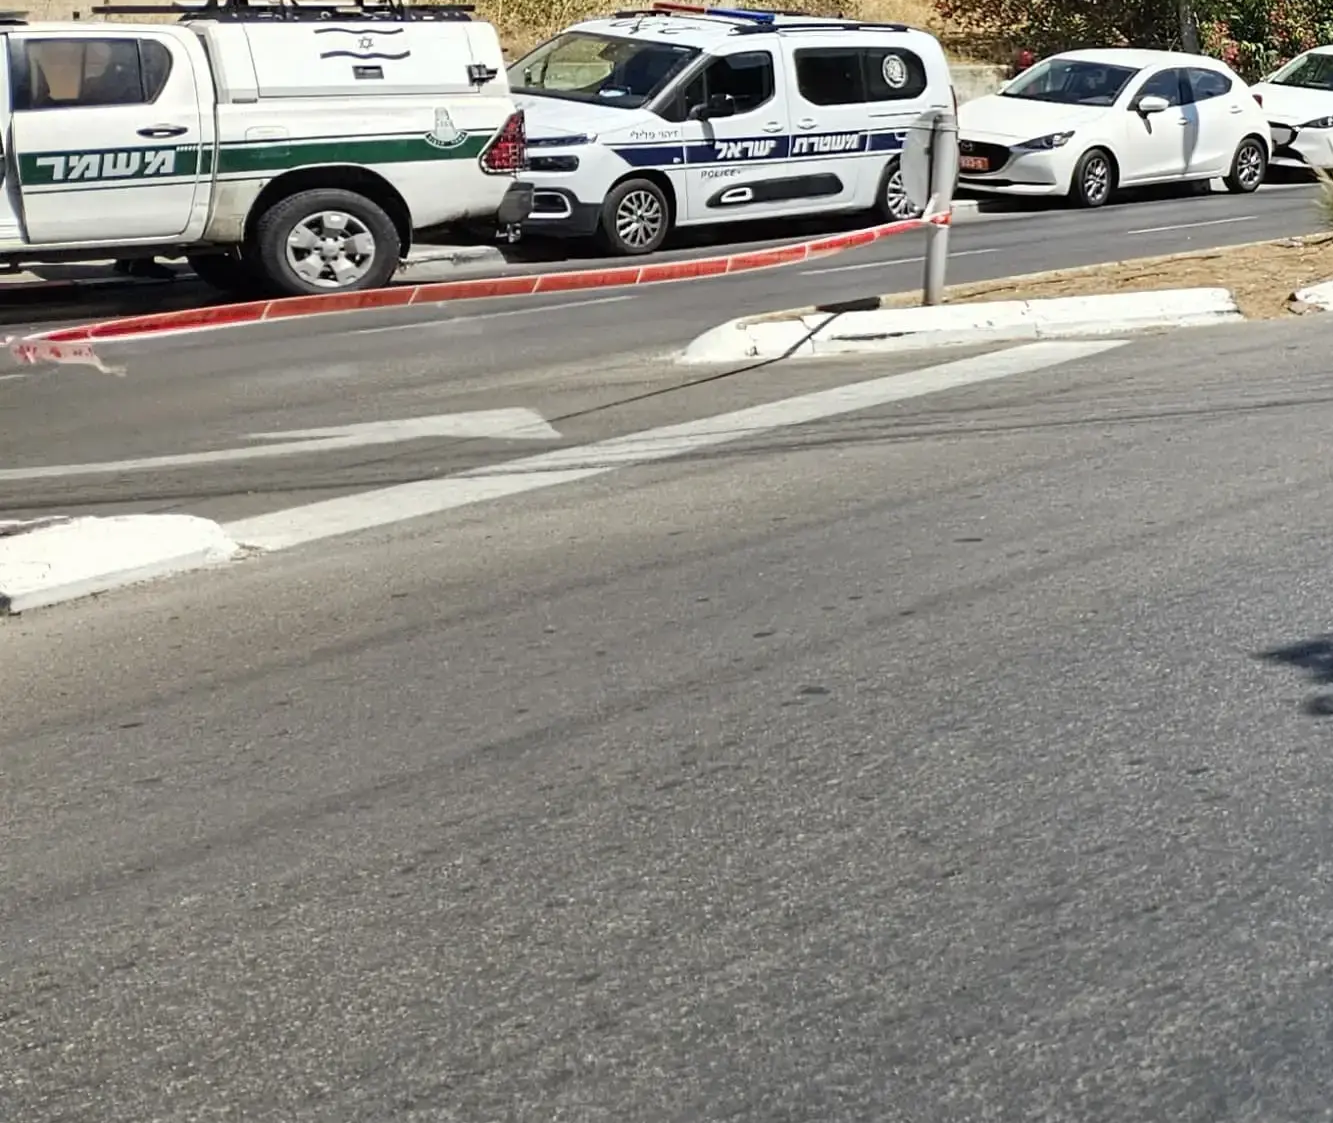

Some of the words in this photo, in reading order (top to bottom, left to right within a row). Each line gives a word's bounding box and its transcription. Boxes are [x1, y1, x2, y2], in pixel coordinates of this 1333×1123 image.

[714, 139, 777, 160] ישראל
[792, 133, 860, 154] משטרת
[36, 149, 176, 181] משמר
[701, 168, 737, 178] POLICE
